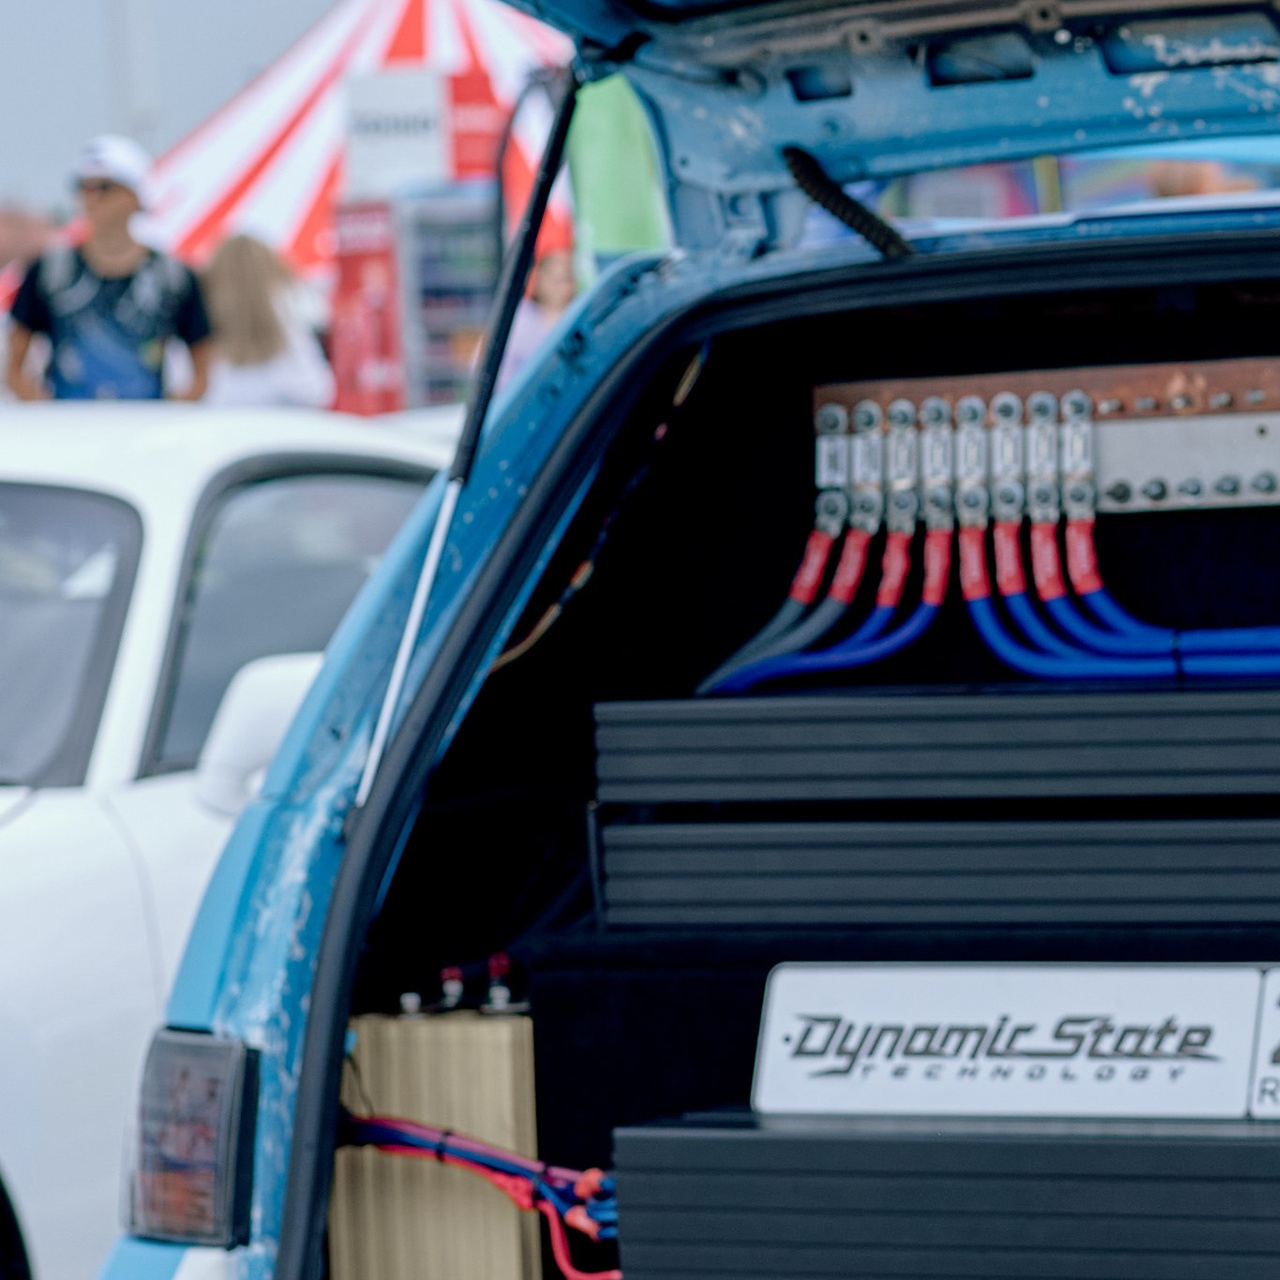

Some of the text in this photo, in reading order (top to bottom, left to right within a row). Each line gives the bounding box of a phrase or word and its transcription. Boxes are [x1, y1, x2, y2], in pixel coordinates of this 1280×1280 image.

[792, 1014, 1223, 1079] Dynamic State
[860, 1064, 1187, 1081] TECHNOLOGY
